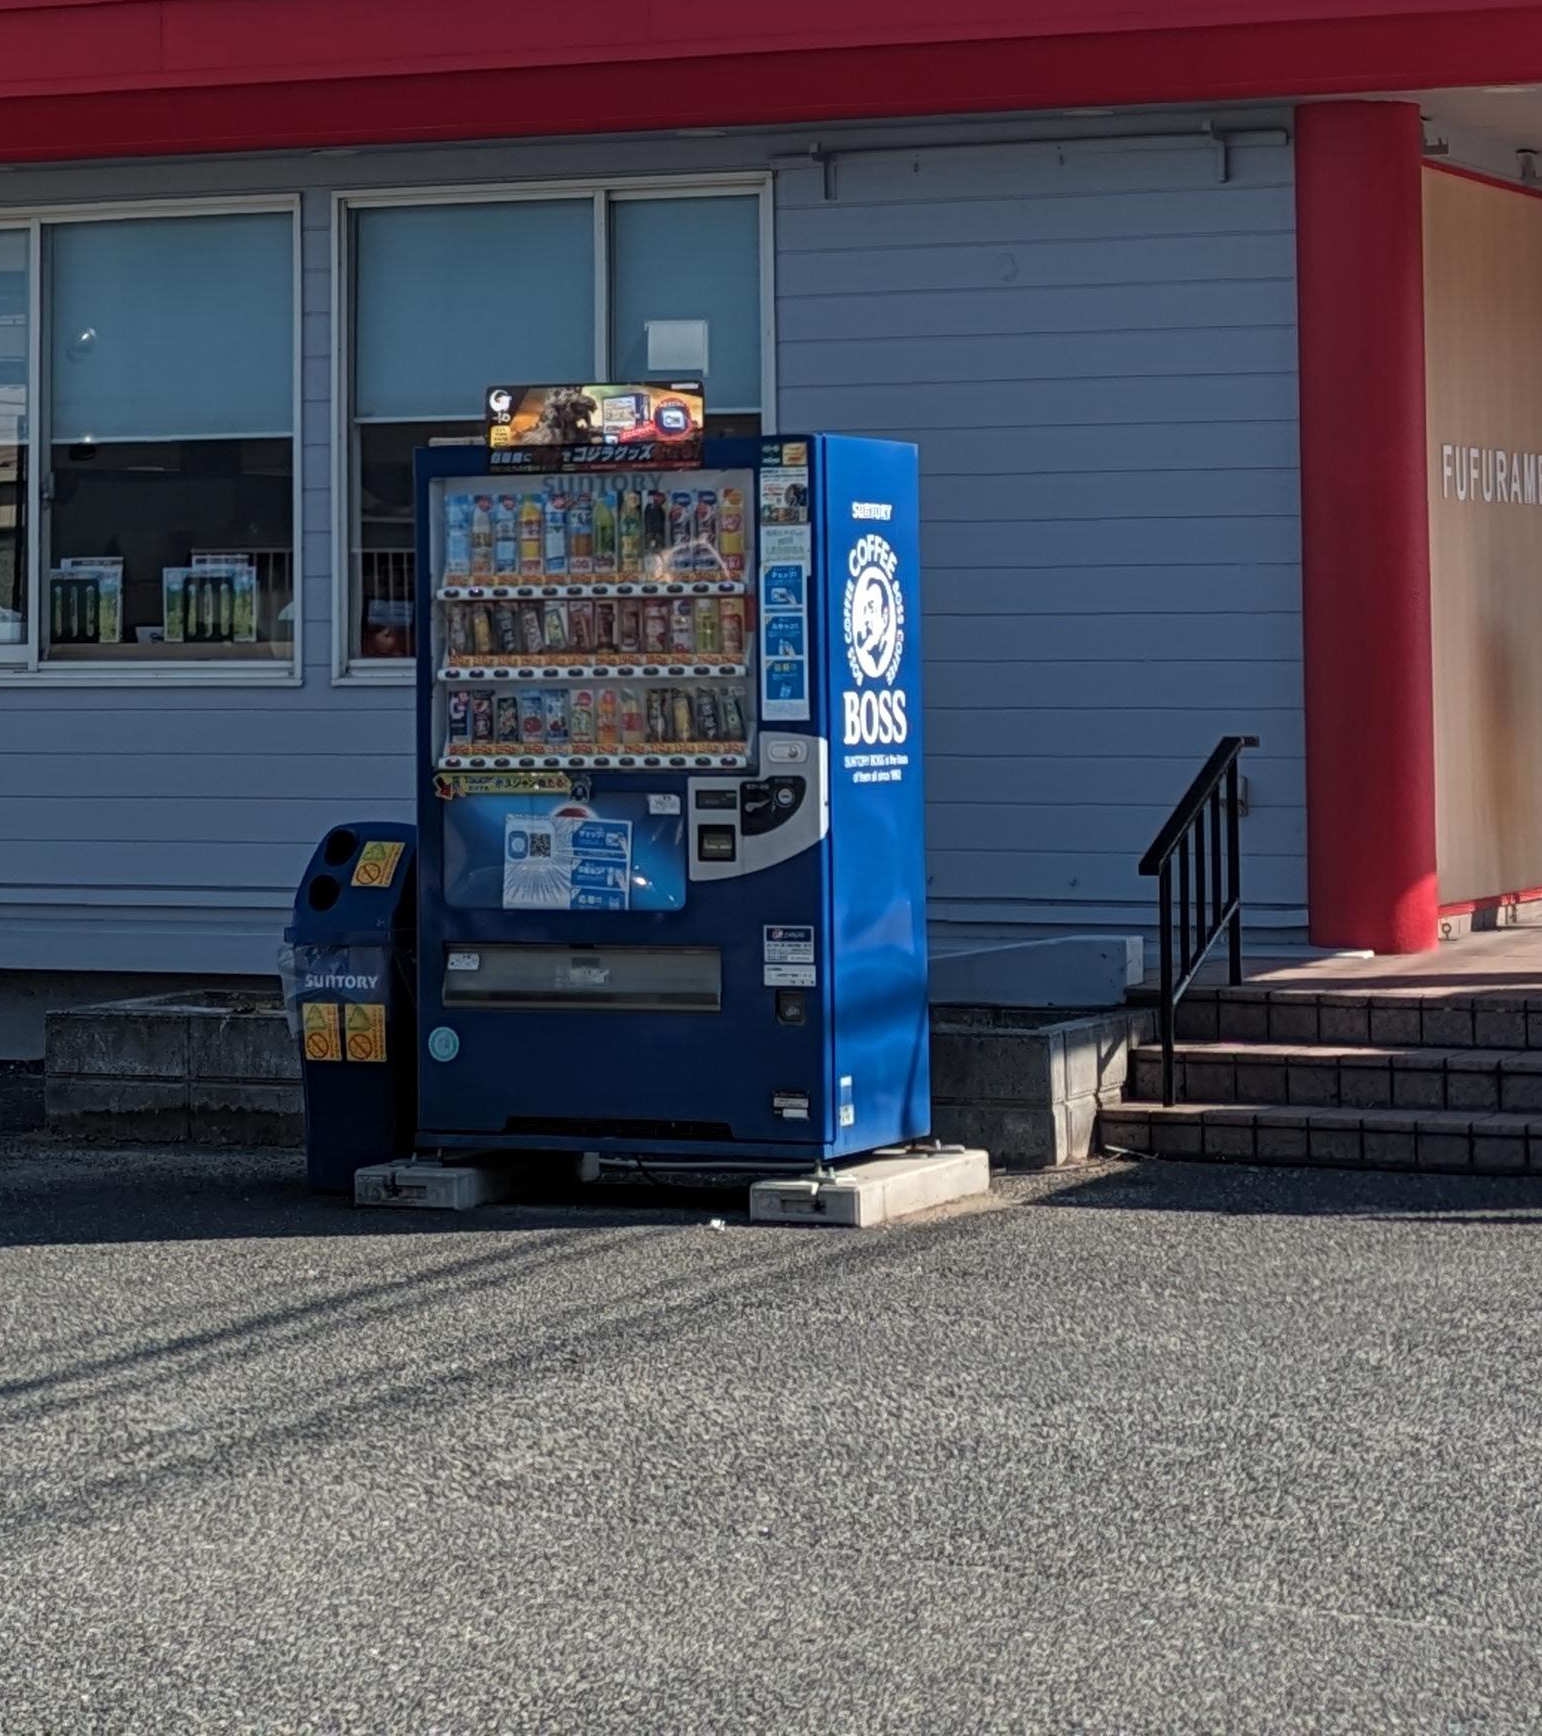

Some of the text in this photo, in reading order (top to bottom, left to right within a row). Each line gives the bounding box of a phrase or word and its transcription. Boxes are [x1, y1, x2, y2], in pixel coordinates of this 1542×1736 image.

[542, 473, 664, 494] SUNTORY
[849, 533, 898, 580] COFFEE
[843, 689, 907, 745] BOSS
[305, 973, 379, 990] SUNTORY
